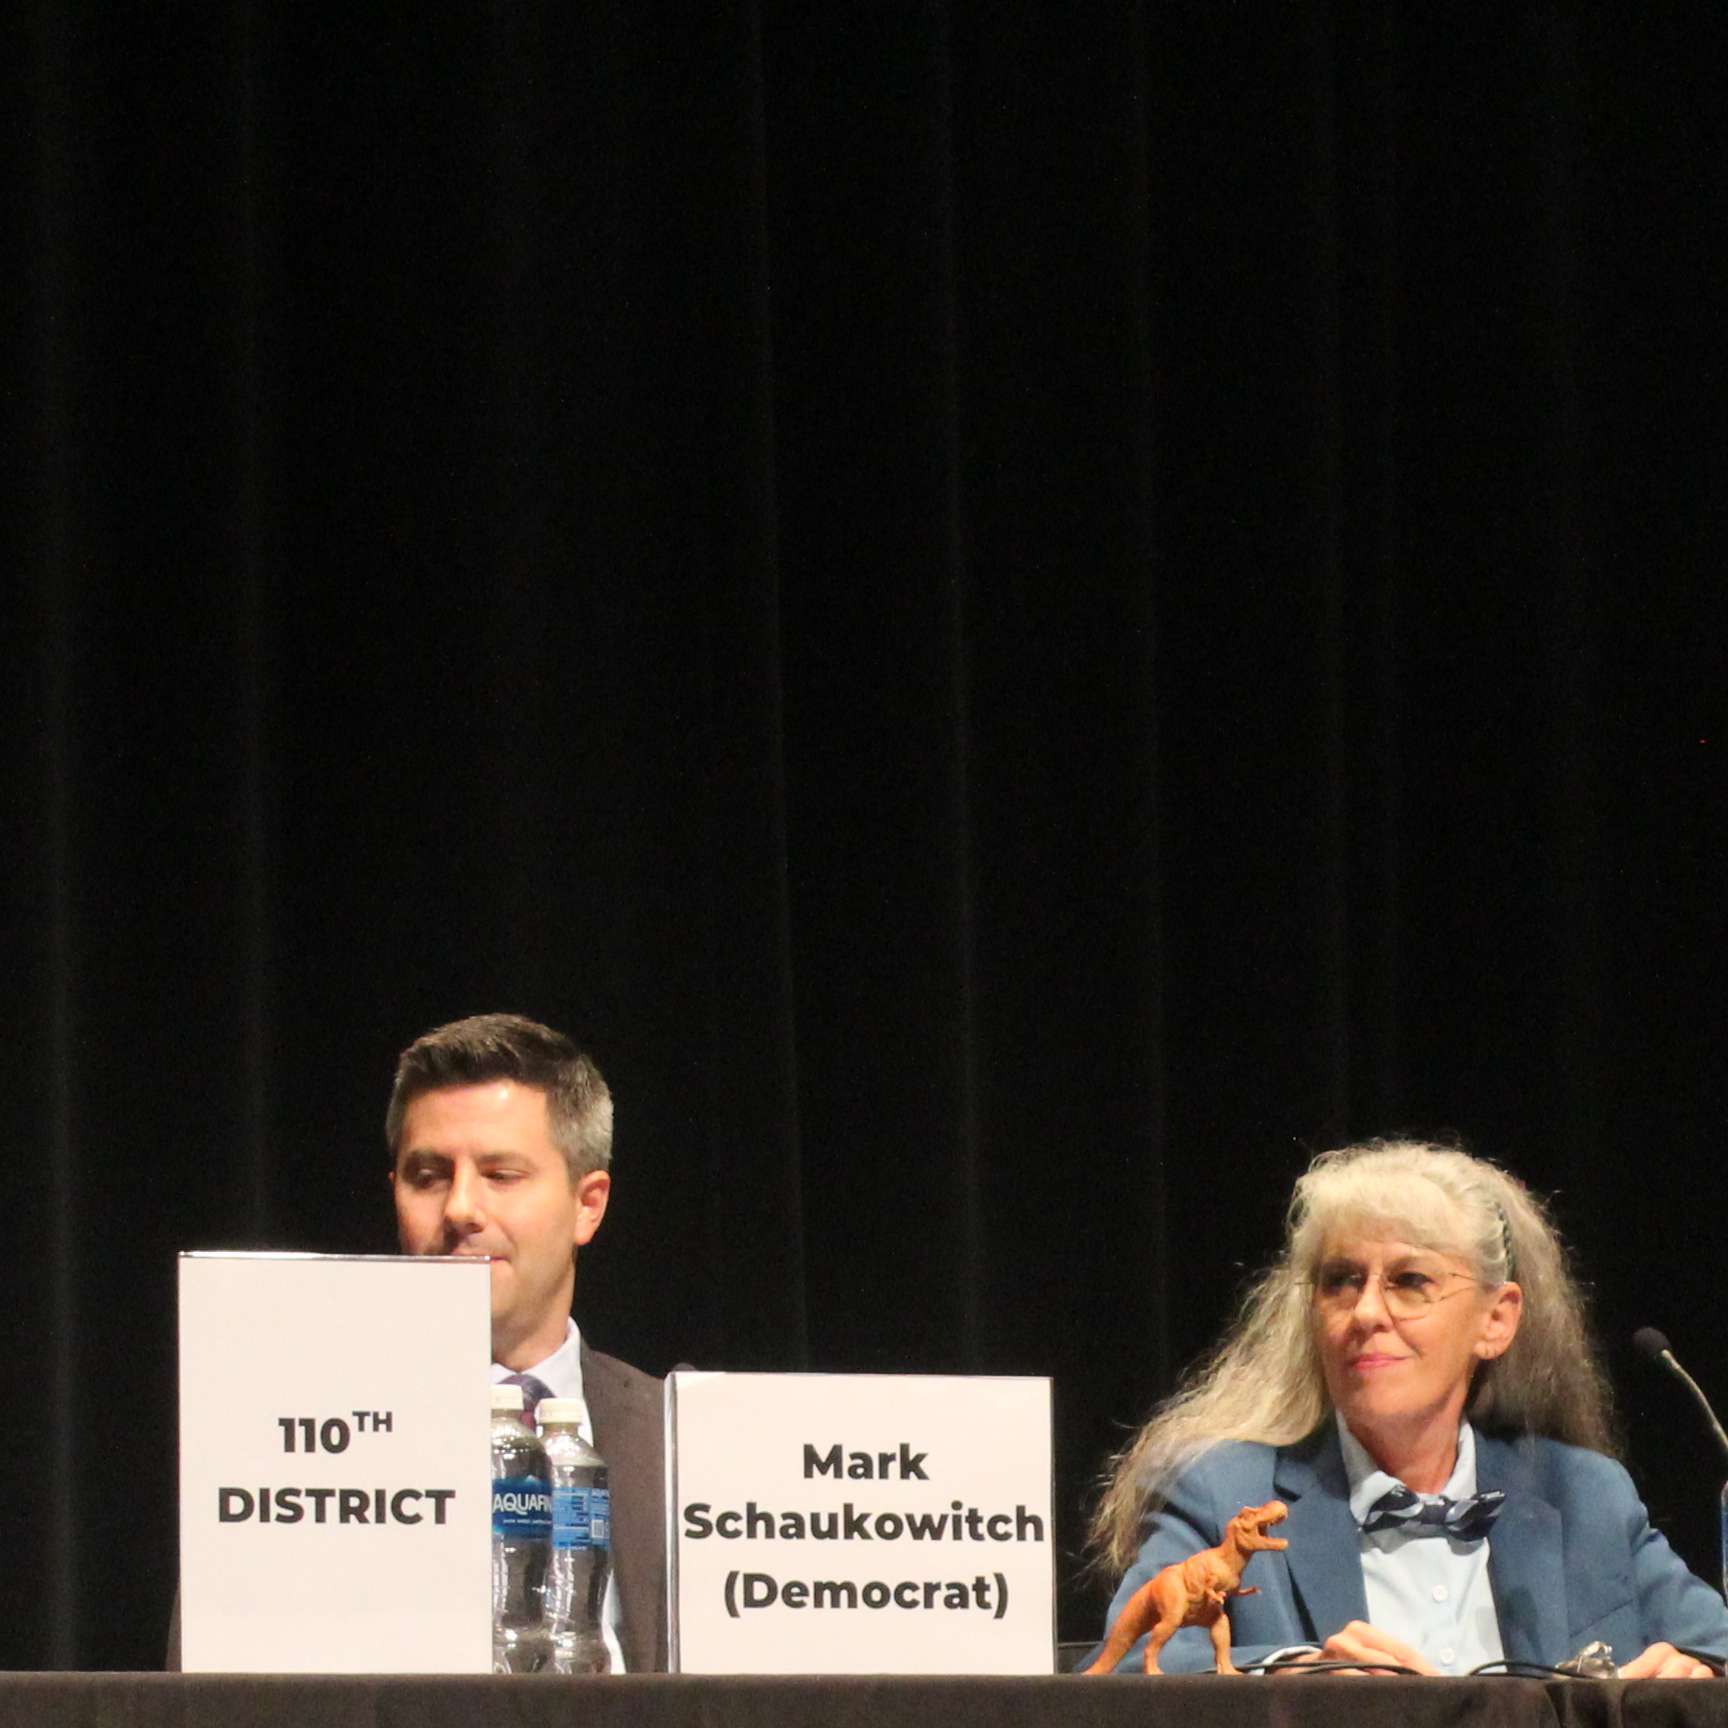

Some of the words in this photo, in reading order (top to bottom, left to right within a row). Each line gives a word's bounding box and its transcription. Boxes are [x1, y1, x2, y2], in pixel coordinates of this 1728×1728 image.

[278, 1410, 394, 1454] 110TH
[803, 1443, 929, 1481] Mark
[218, 1487, 456, 1525] DISTRICT
[683, 1501, 1045, 1543] Schaukowitch
[724, 1570, 1009, 1620] (Democrat)
